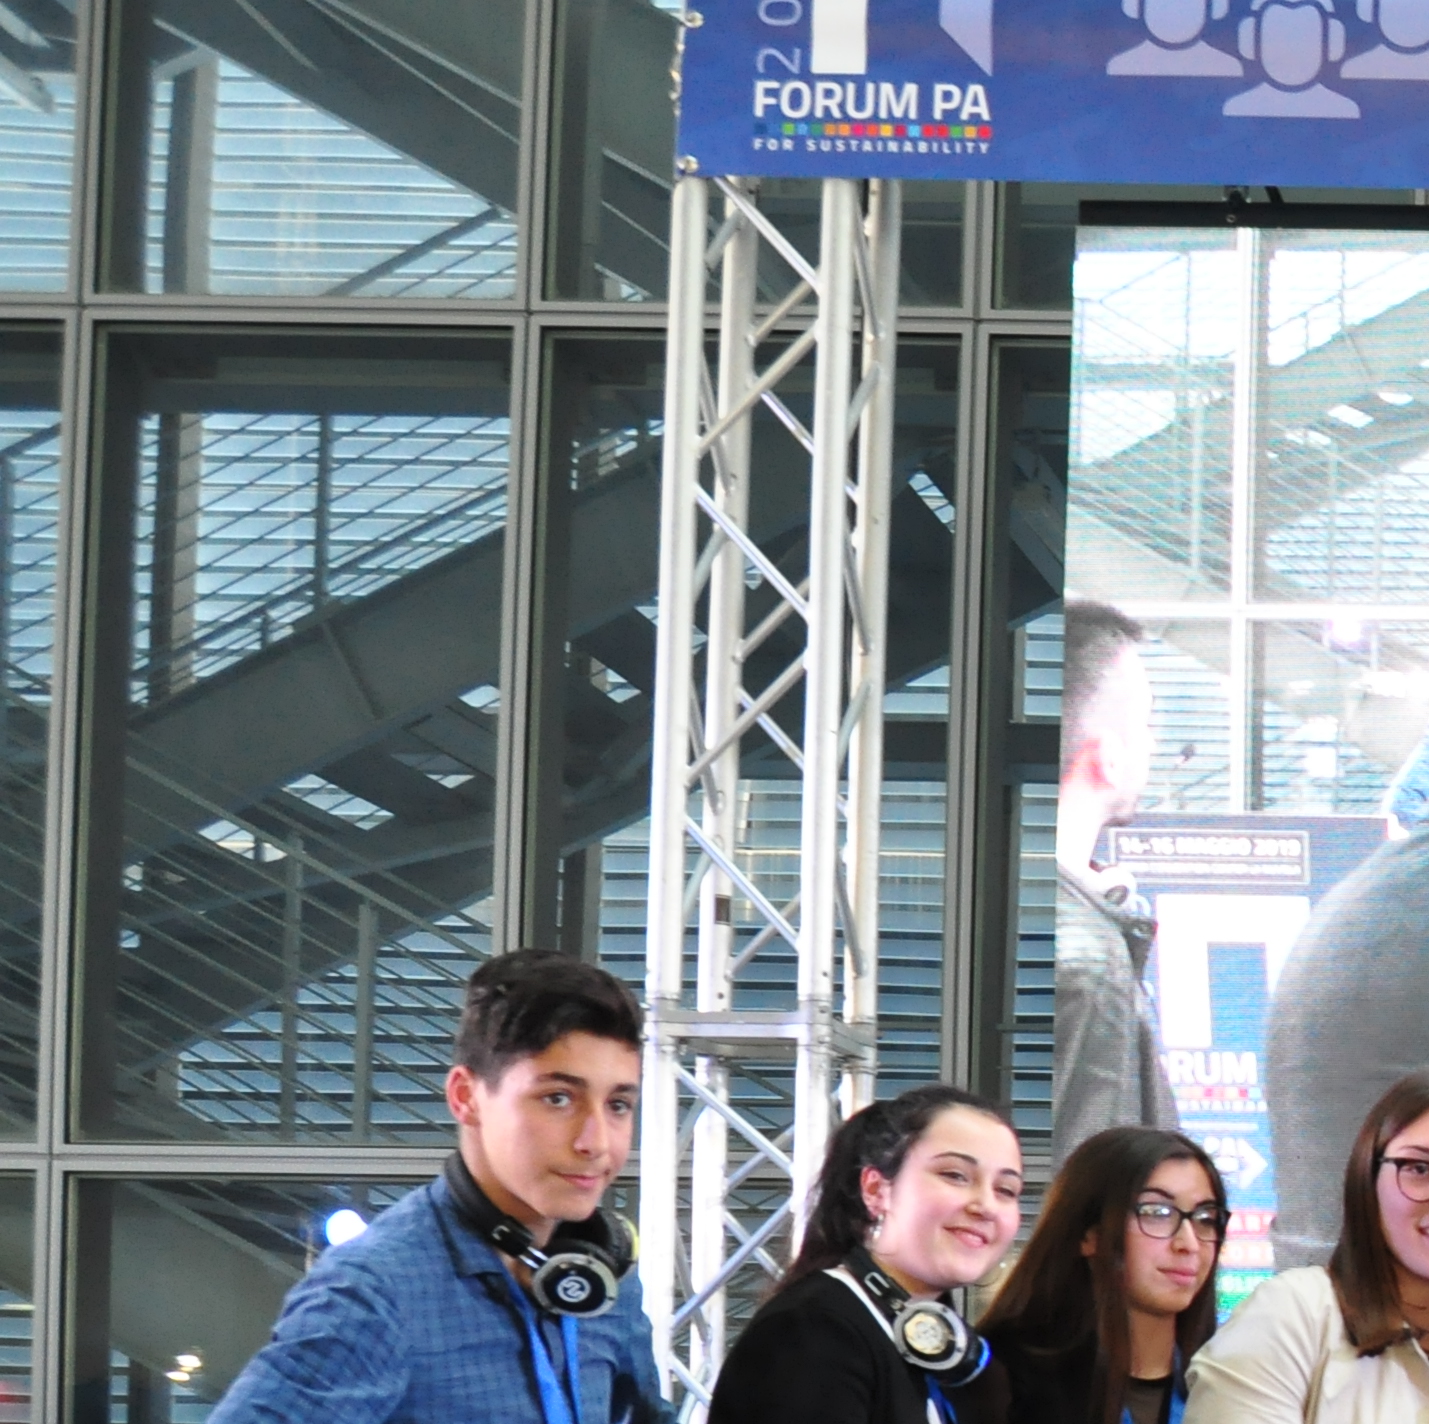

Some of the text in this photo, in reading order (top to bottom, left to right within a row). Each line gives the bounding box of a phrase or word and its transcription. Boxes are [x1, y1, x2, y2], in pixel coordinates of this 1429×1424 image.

[754, 80, 992, 121] FORUM PA
[754, 138, 990, 154] FOR SUSTAINABILITY
[1160, 1052, 1258, 1084] RUM
